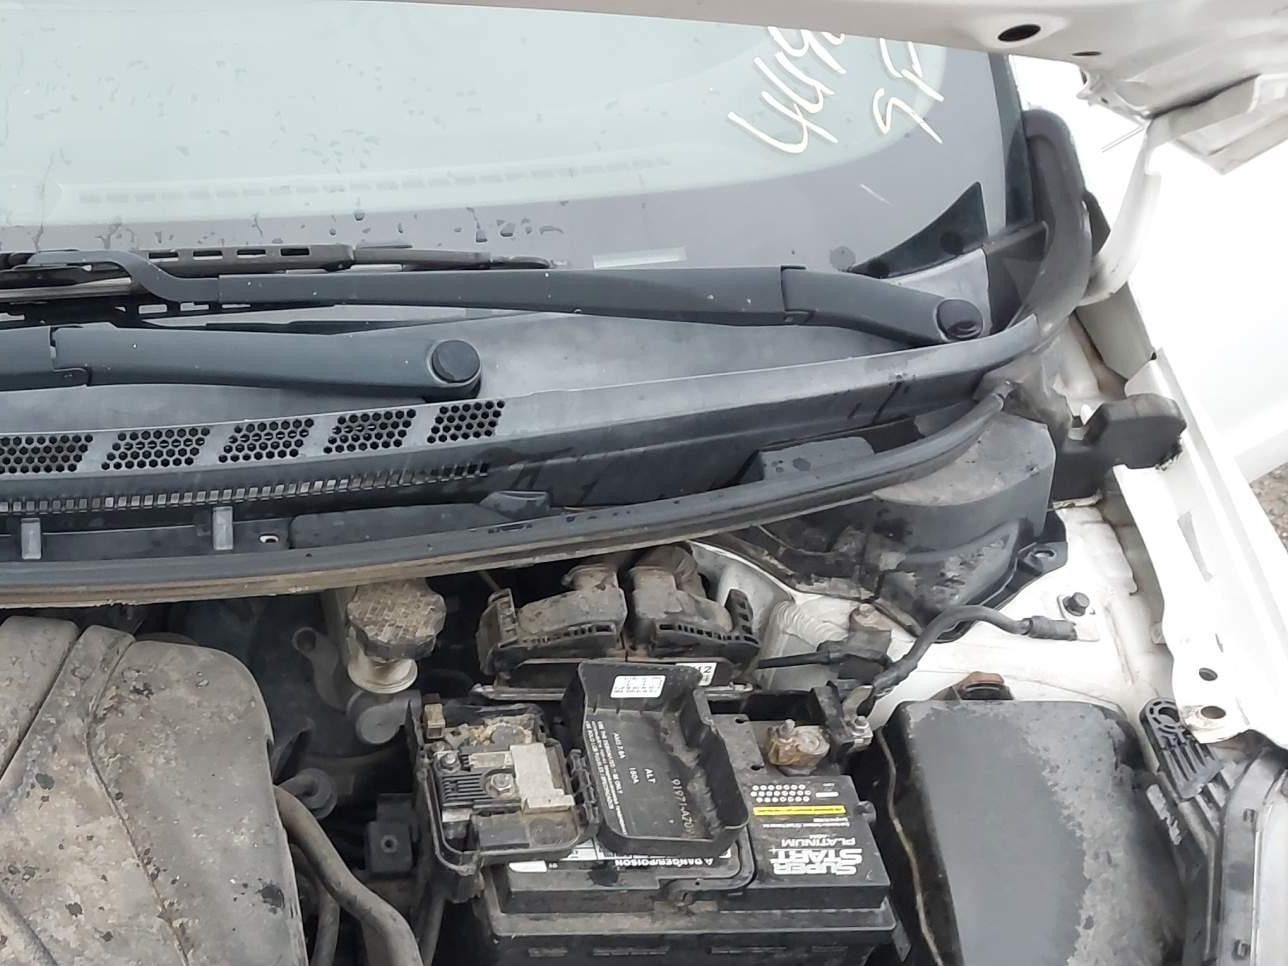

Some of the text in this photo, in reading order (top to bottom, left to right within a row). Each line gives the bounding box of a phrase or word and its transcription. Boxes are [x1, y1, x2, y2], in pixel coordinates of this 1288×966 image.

[726, 26, 846, 154] 449
[644, 768, 657, 784] ALT
[781, 838, 856, 848] PLATINUM
[769, 848, 863, 865] START
[773, 862, 857, 876] SUPER
